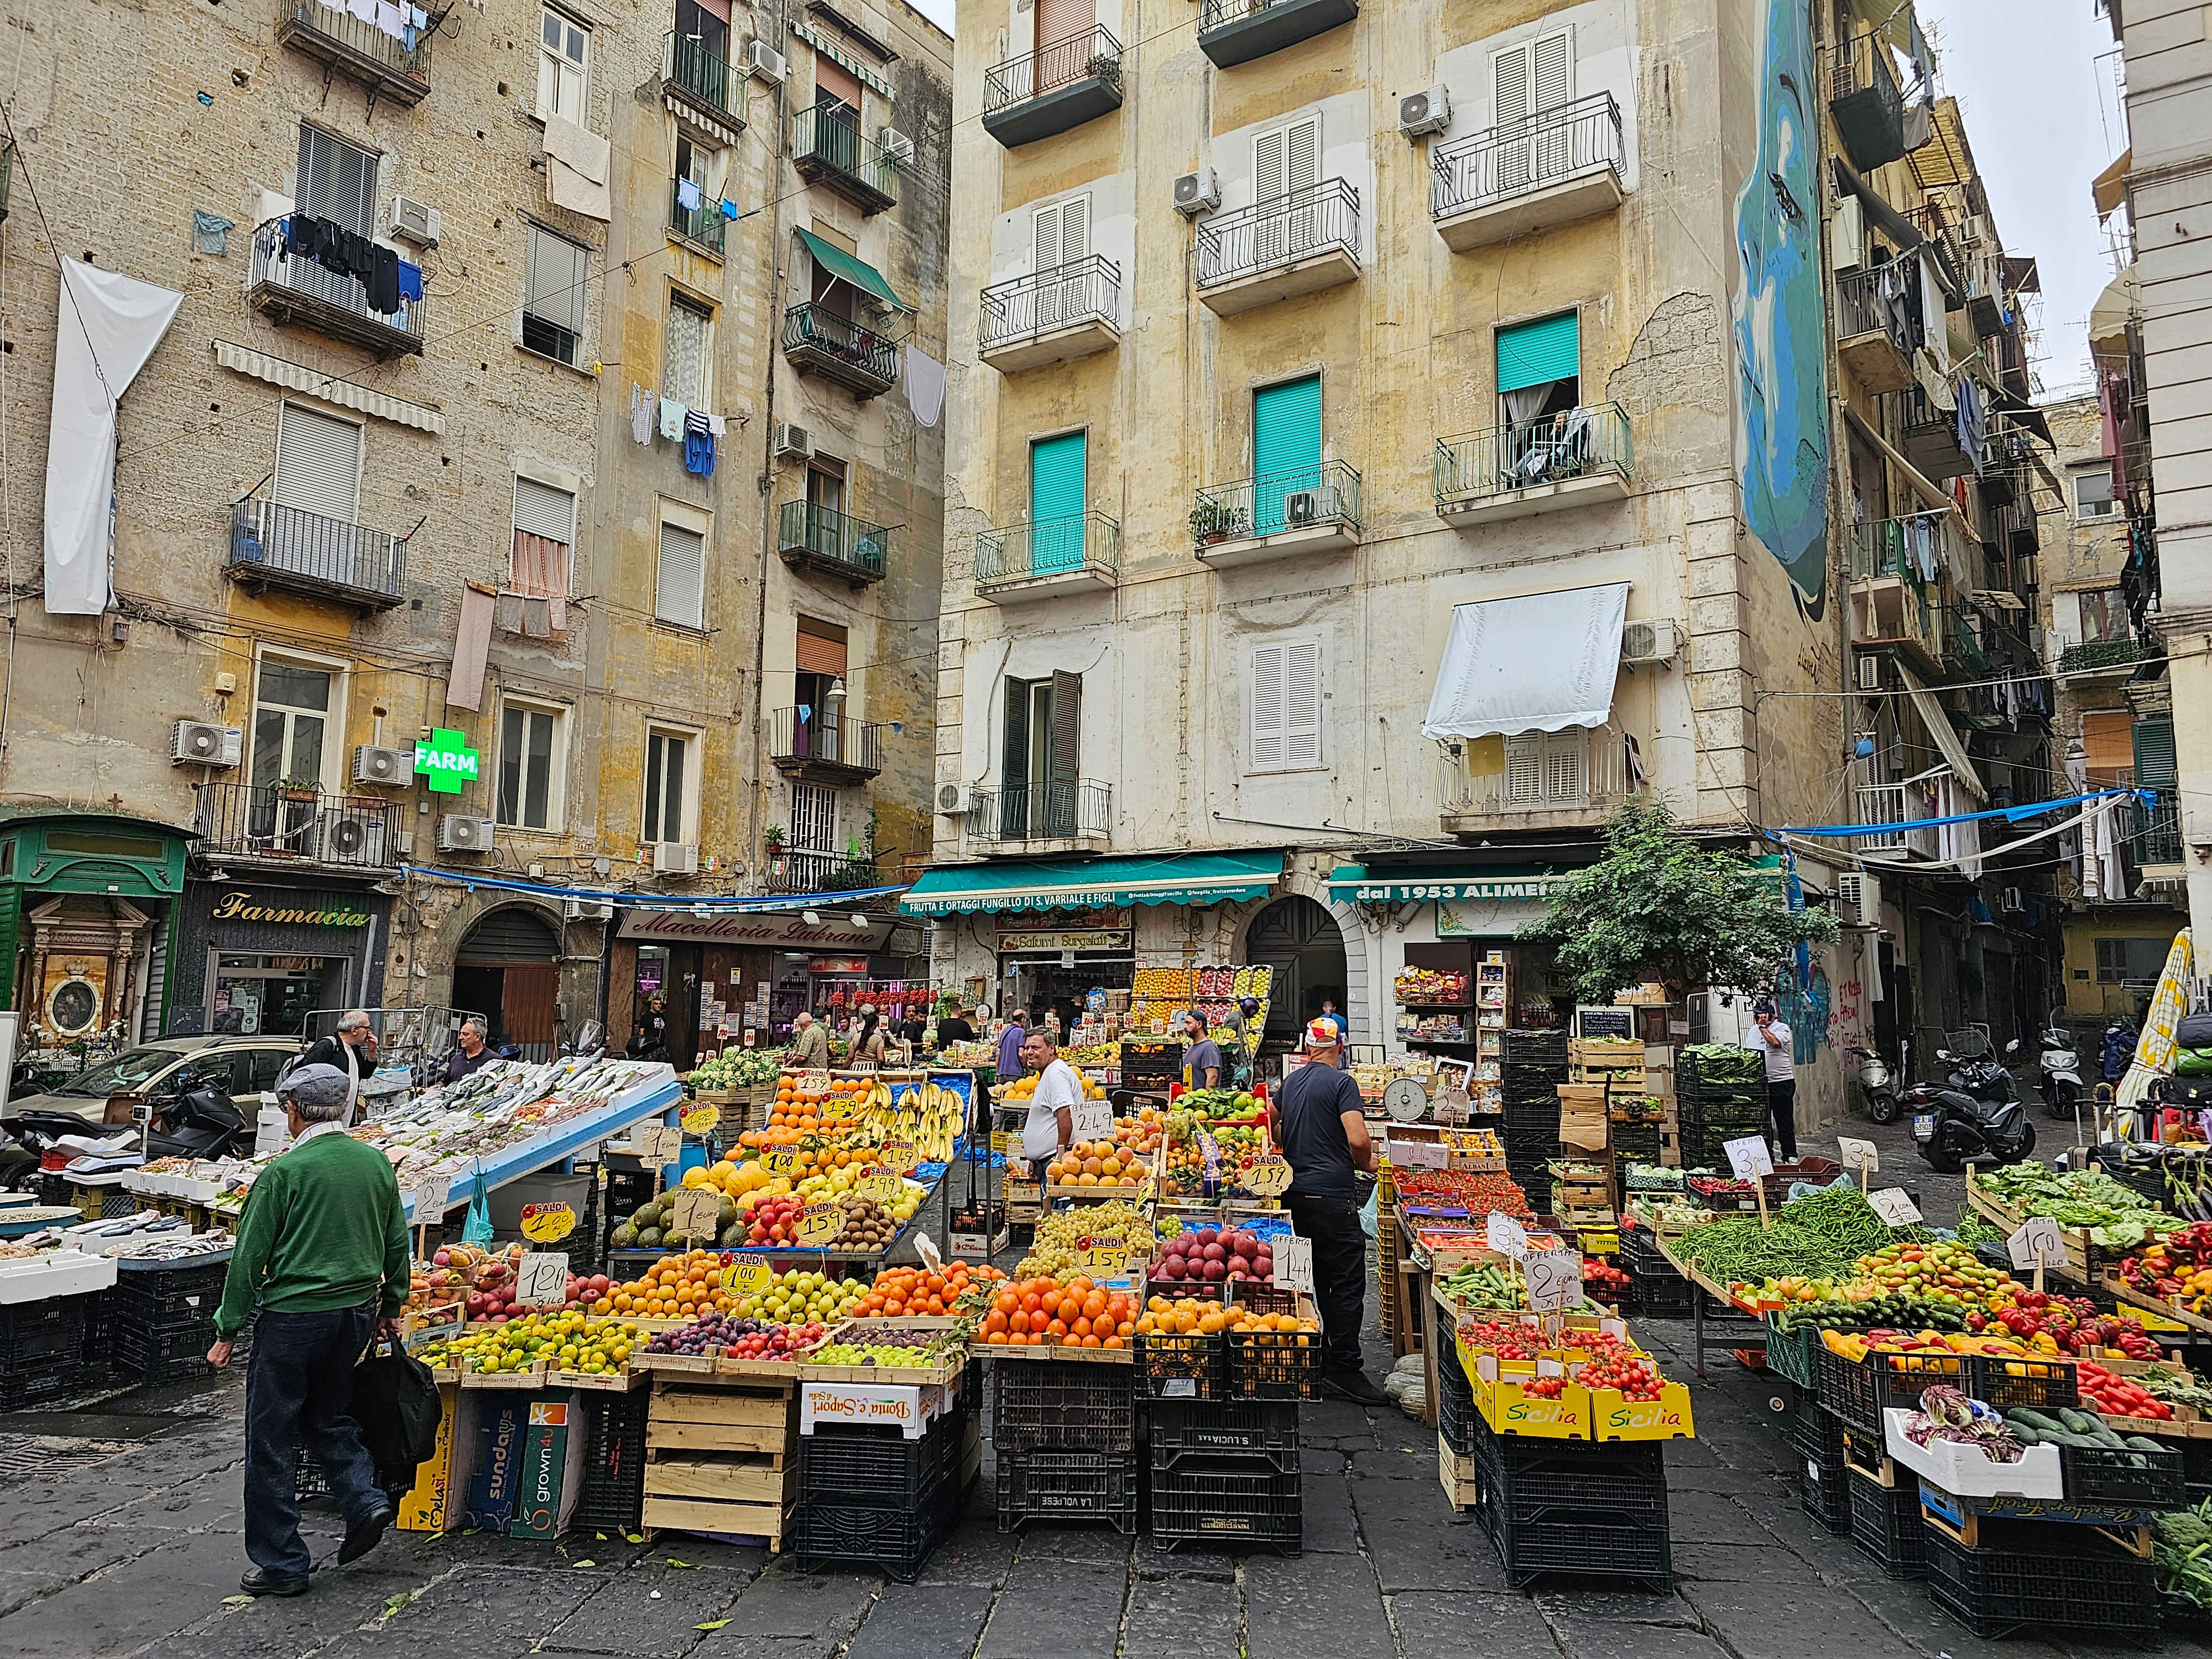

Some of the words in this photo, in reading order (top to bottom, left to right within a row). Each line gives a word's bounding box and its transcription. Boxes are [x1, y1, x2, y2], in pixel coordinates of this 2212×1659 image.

[415, 748, 477, 773] FARM
[910, 902, 937, 912] FRUTTA
[940, 902, 943, 910] E
[946, 900, 980, 910] ORTAGGI
[982, 897, 1021, 909] FUNGILLO
[1024, 896, 1033, 907] DI
[1036, 896, 1042, 906] S.
[1045, 894, 1084, 905] VARRIALE
[1087, 894, 1092, 903] E
[1093, 892, 1115, 903] FIGLI
[1356, 886, 1390, 900] dal
[1401, 885, 1455, 899] 1953
[213, 892, 371, 927] Farmacia
[633, 913, 779, 938] Macelleria
[779, 920, 878, 944] Lubrano
[1018, 935, 1055, 948] Salumi
[688, 1102, 709, 1112] SALDI
[648, 1131, 663, 1158] 1
[771, 1144, 796, 1154] SALDI
[891, 1140, 912, 1149] SALDI
[1849, 1142, 1864, 1162] 3
[1254, 1156, 1282, 1165] SALDI
[1737, 1149, 1753, 1173] 3
[419, 1186, 435, 1214] 2
[676, 1191, 718, 1200] OFFERTA
[536, 1203, 565, 1213] SALDI
[677, 1197, 701, 1230] 1
[804, 1202, 834, 1215] SALDI
[1878, 1198, 1911, 1219] 2
[1092, 1237, 1121, 1248] SALDI
[1272, 1235, 1311, 1248] OFFERTA
[1495, 1224, 1511, 1246] 3
[732, 1254, 763, 1266] SALDI
[1277, 1244, 1311, 1282] 140
[1522, 1248, 1572, 1262] OFFERTA
[520, 1261, 565, 1298] 120
[1532, 1264, 1567, 1298] 2
[808, 1391, 826, 1401] Sicilia
[813, 1396, 857, 1416] Sapori
[869, 1401, 911, 1419] Bonta'
[1506, 1403, 1578, 1426] Sicilia
[1608, 1408, 1682, 1428] Sicilia
[442, 1413, 451, 1446] Melinda
[490, 1410, 516, 1500] sundays
[536, 1428, 554, 1502] grown4u
[1042, 1496, 1078, 1506] VOLPESE
[1080, 1498, 1092, 1507] LA
